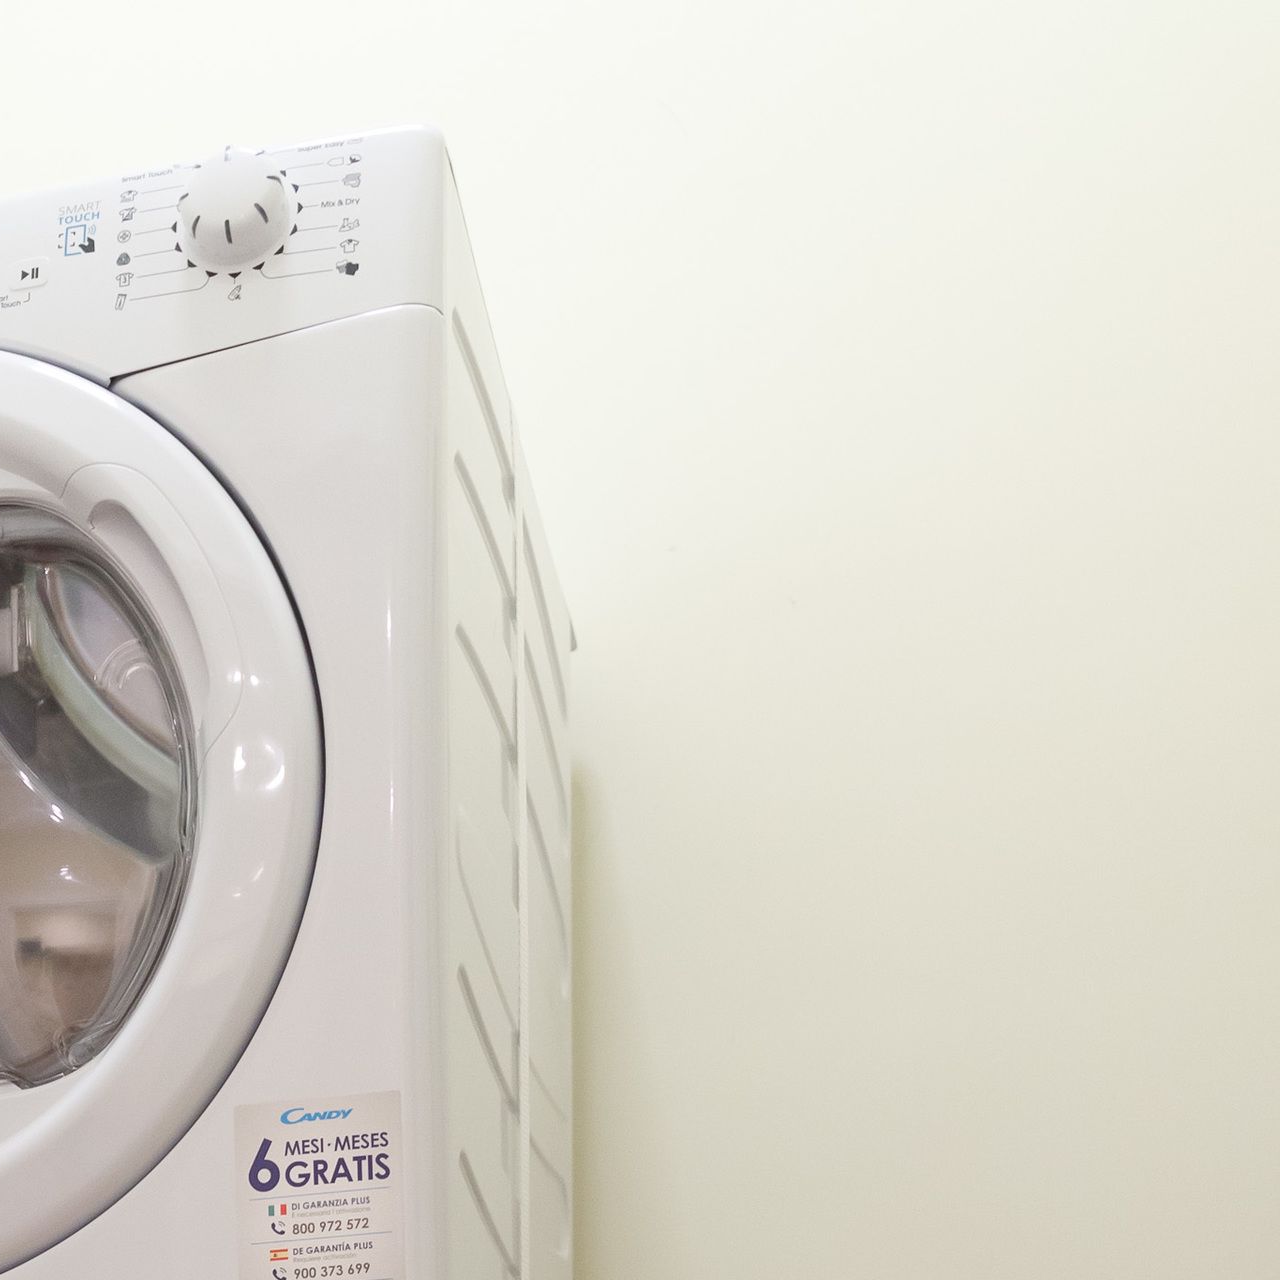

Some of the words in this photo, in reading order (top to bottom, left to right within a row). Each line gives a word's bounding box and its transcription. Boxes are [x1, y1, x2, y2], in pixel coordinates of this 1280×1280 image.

[58, 200, 101, 216] SMART
[345, 198, 360, 206] Dry
[58, 212, 100, 225] TOUCH
[280, 1107, 353, 1125] CANDY
[284, 1138, 324, 1156] MESI
[334, 1132, 389, 1152] MESES
[248, 1138, 281, 1192] 6
[285, 1153, 391, 1188] GRATIS
[291, 1202, 300, 1211] DI
[303, 1199, 348, 1210] GARANZIA
[351, 1196, 370, 1205] PLUS
[292, 1223, 315, 1235] 800
[320, 1220, 342, 1232] 972
[347, 1218, 369, 1230] 572
[293, 1247, 303, 1255] DE
[306, 1242, 351, 1255] GARANTÍA
[354, 1241, 373, 1250] PLUS
[293, 1266, 317, 1280] 900
[320, 1265, 343, 1277] 373
[348, 1262, 371, 1275] 699
